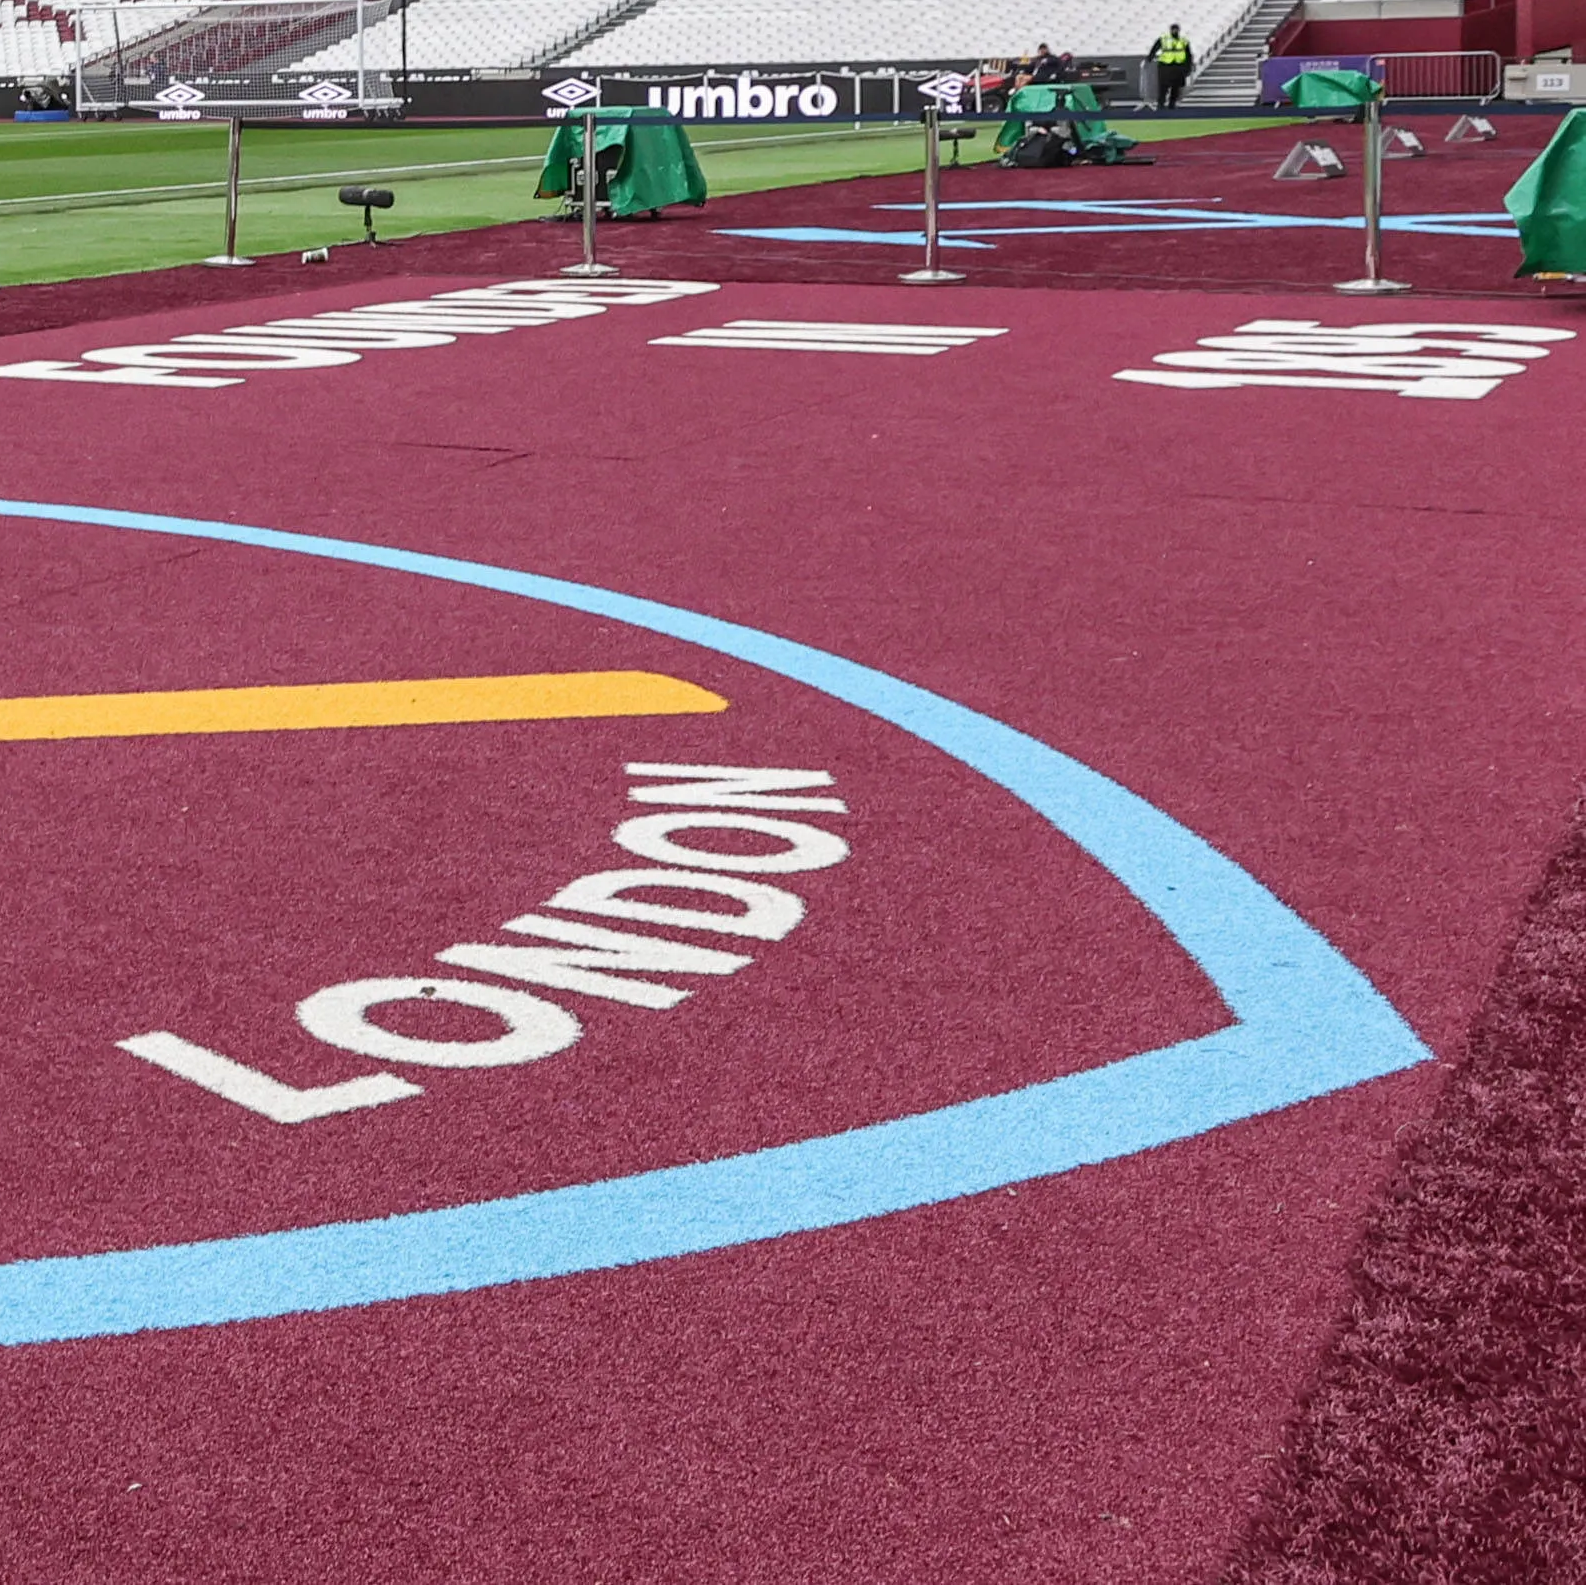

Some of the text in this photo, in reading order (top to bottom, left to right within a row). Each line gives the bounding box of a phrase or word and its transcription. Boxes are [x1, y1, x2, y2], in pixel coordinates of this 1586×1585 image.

[159, 108, 200, 120] umbro
[302, 108, 347, 119] umbro
[648, 78, 837, 118] umbro
[648, 320, 1011, 356] IN
[1112, 319, 1578, 400] 1895
[113, 761, 851, 1124] LONDON
